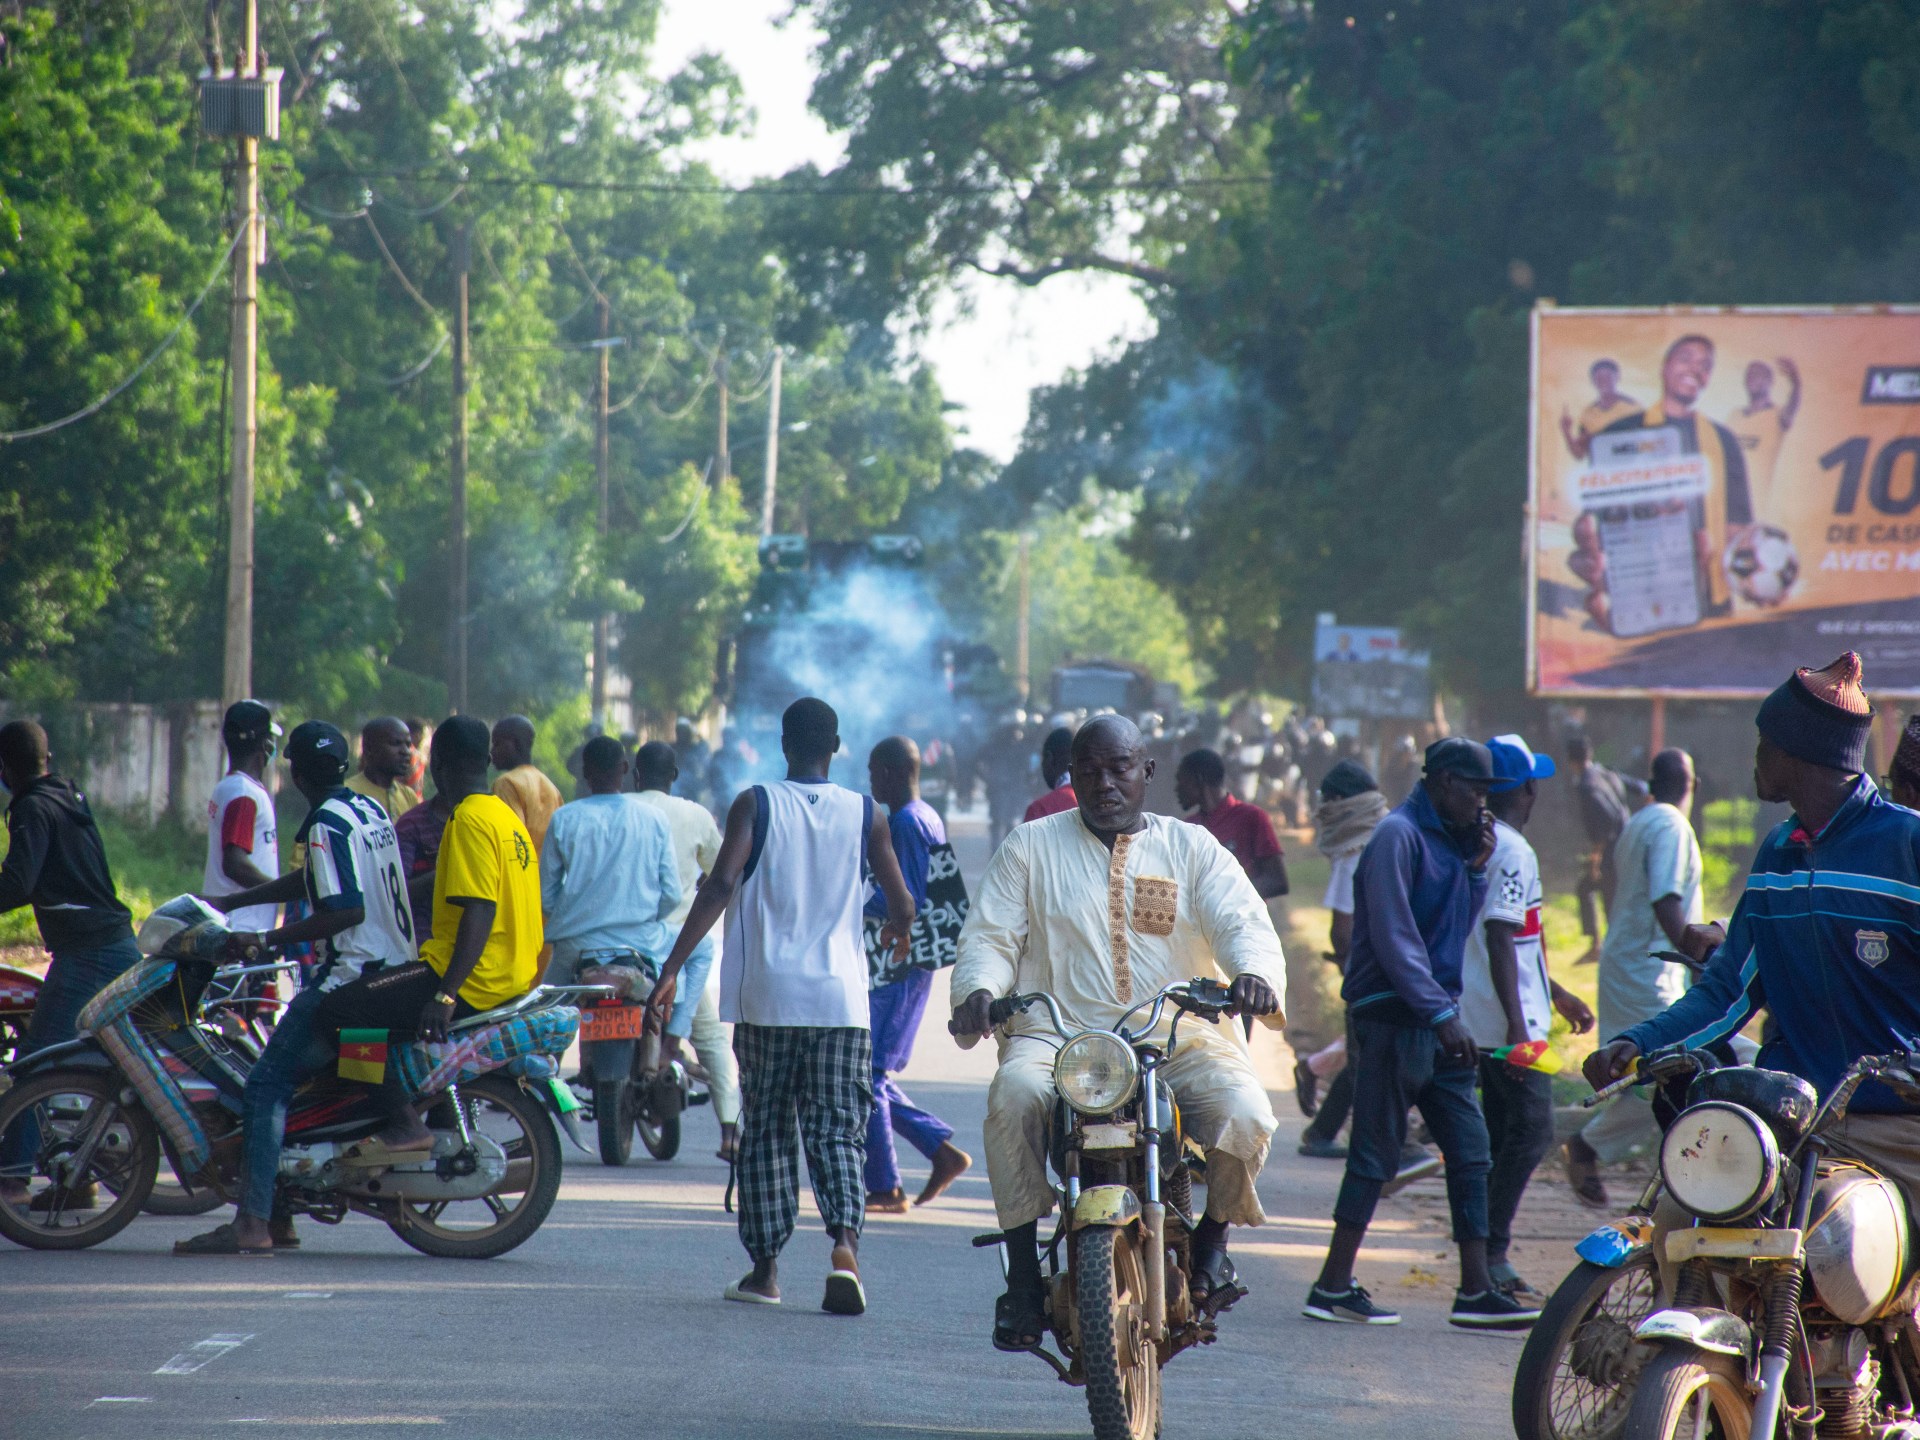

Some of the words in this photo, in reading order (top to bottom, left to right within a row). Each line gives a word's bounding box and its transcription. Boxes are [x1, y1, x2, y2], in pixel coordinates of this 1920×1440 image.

[1819, 436, 1920, 516] 10
[1825, 523, 1860, 544] DE
[1819, 550, 1889, 571] AVEC
[381, 862, 412, 943] 18
